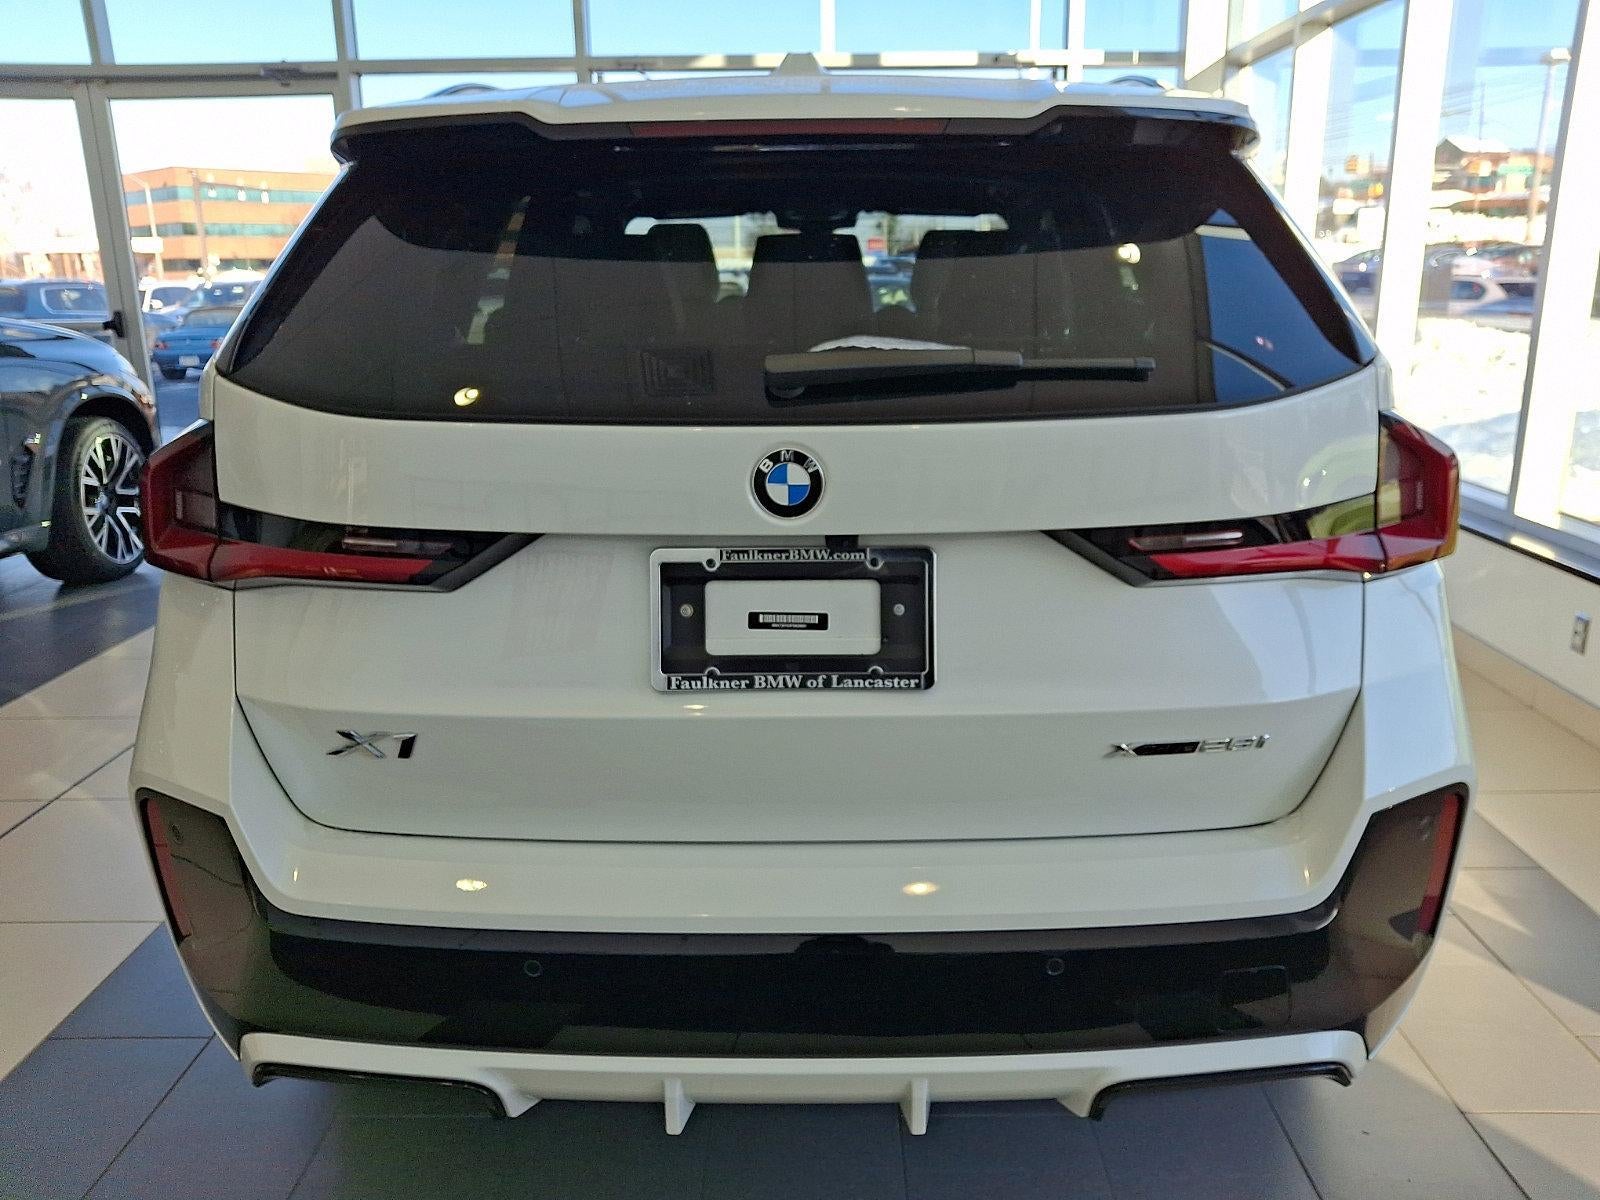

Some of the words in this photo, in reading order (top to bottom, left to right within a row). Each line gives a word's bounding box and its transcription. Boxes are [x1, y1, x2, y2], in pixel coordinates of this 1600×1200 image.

[759, 450, 820, 474] BMW
[721, 549, 866, 561] FaulknerBMW.com
[669, 676, 750, 690] Faulkner
[754, 675, 804, 689] BMW
[806, 674, 827, 688] of
[830, 674, 920, 689] Lancaster
[326, 730, 418, 759] X1
